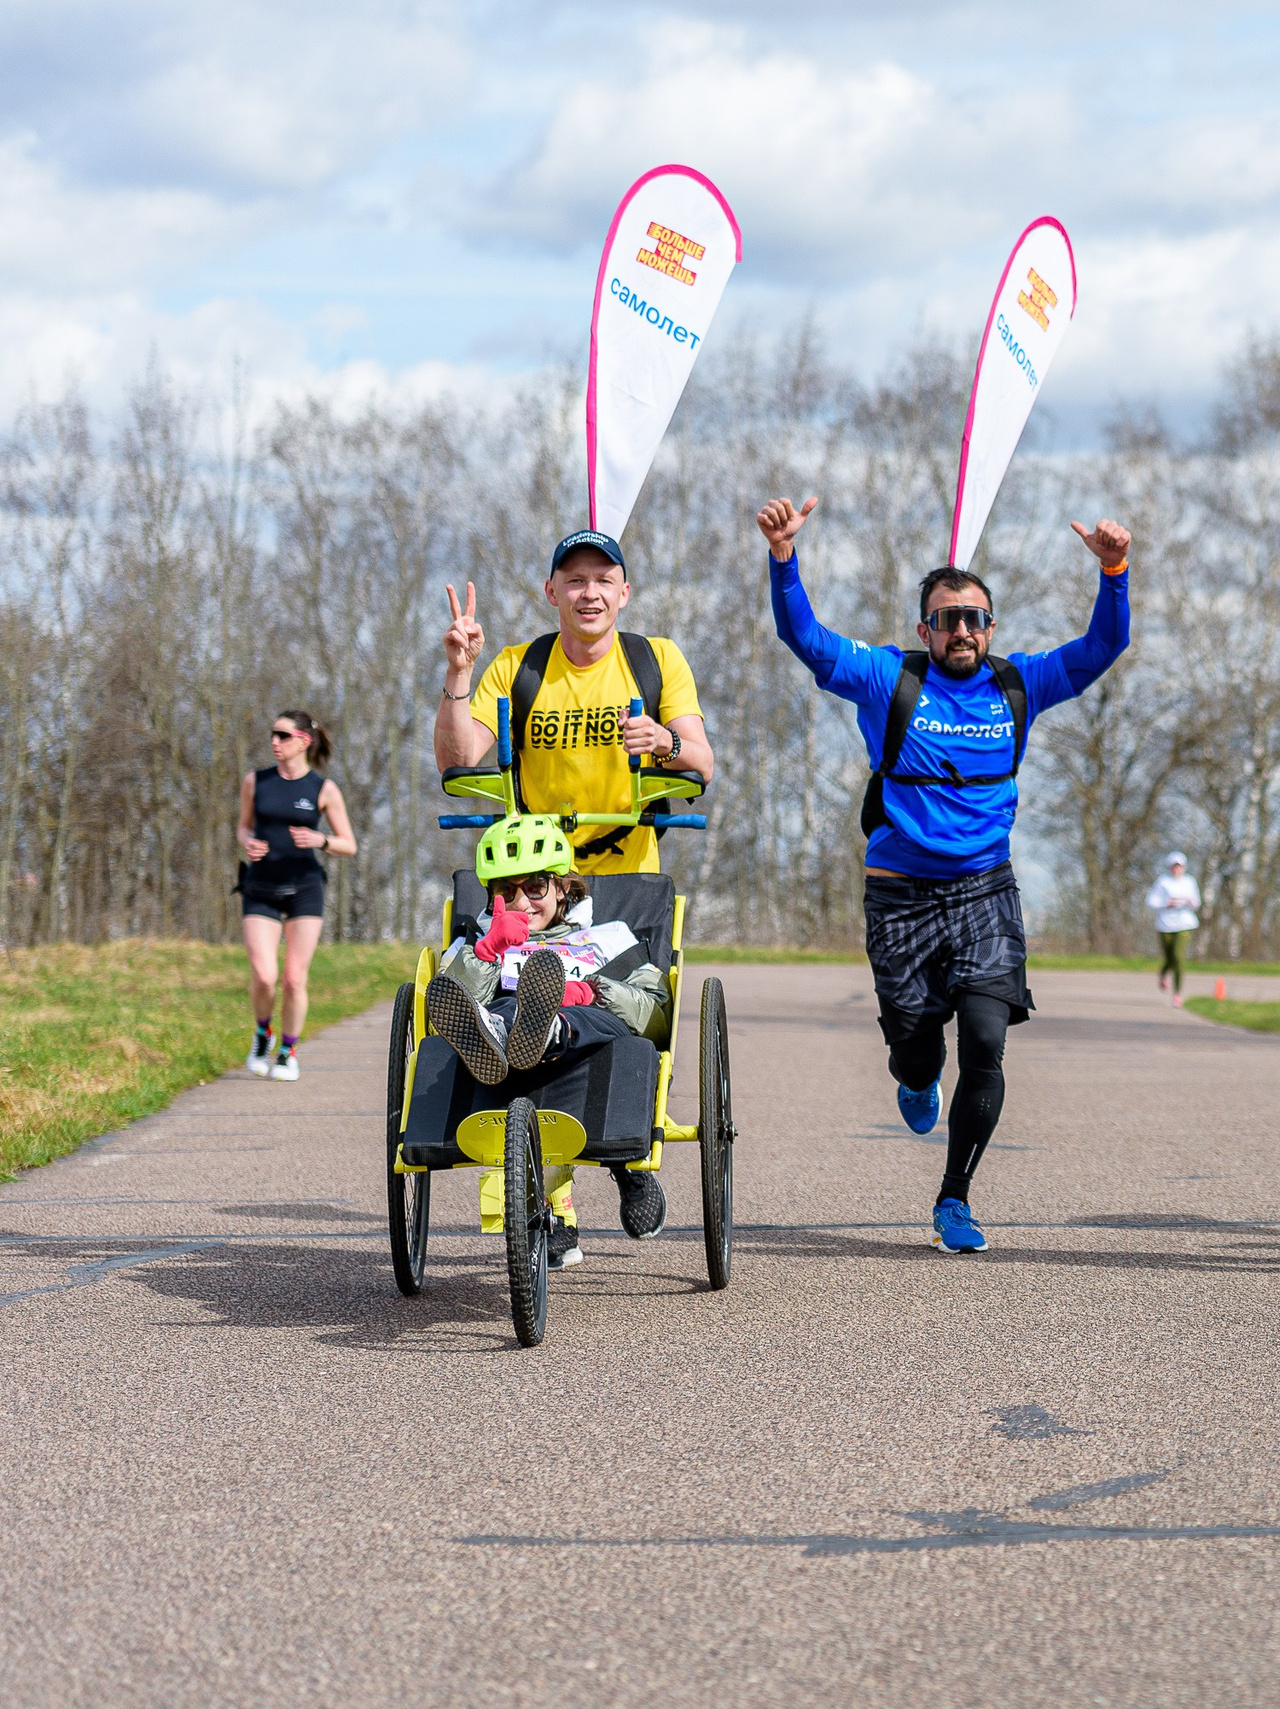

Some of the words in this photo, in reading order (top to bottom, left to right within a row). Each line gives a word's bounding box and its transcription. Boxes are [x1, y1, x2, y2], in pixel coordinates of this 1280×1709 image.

[649, 223, 704, 260] БОЛЬШЕ
[657, 241, 684, 265] ЧЕМ
[637, 249, 695, 285] МОЖЕШЬ
[610, 277, 701, 350] самолет
[562, 532, 609, 547] Leadership
[913, 716, 1015, 739] самолет
